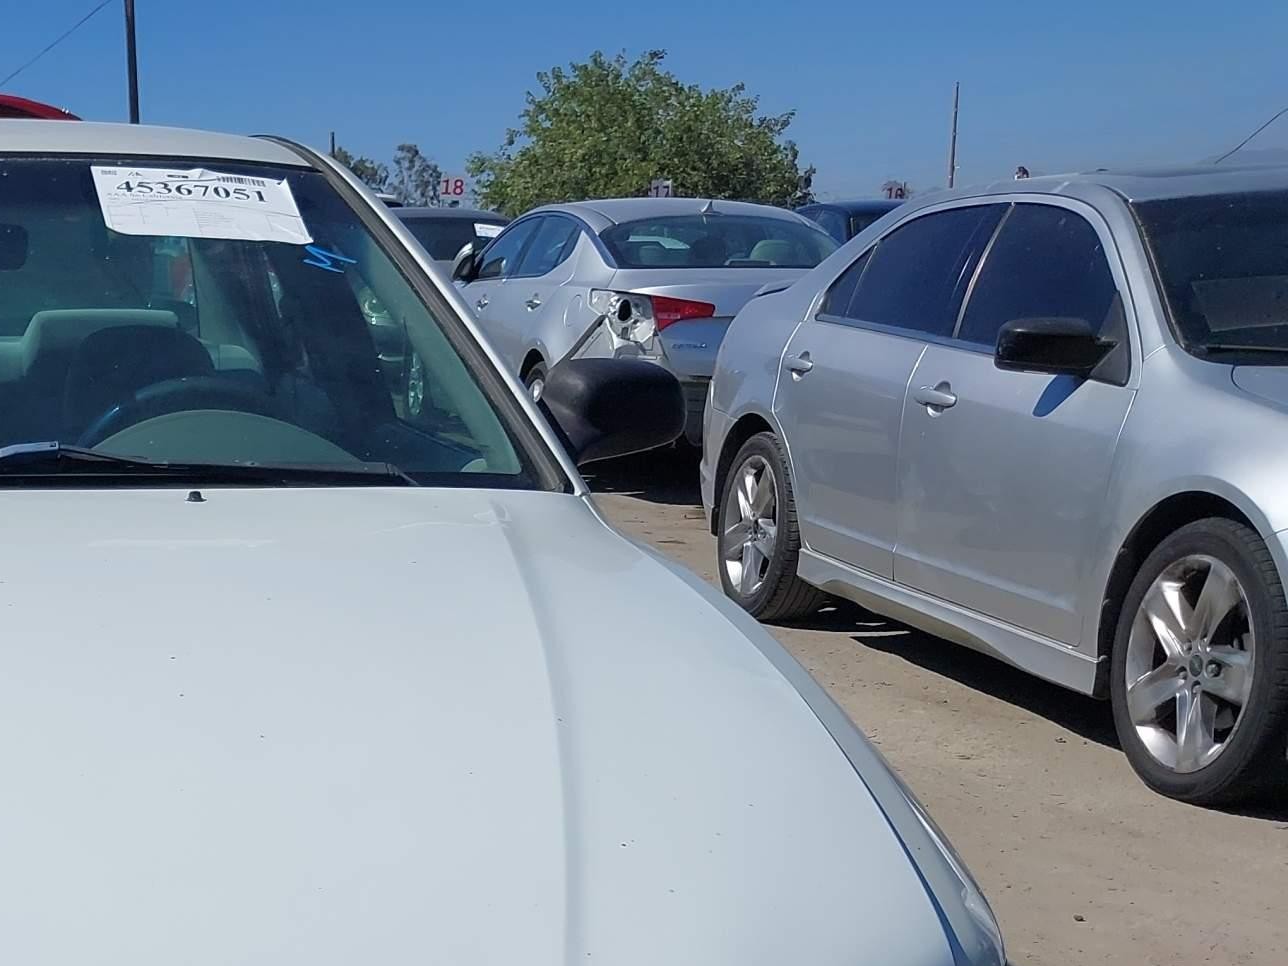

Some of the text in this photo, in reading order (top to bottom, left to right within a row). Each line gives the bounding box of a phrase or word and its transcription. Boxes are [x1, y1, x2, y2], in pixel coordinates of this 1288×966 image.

[116, 180, 267, 203] 45367051
[440, 178, 464, 196] 18
[652, 185, 670, 198] 17
